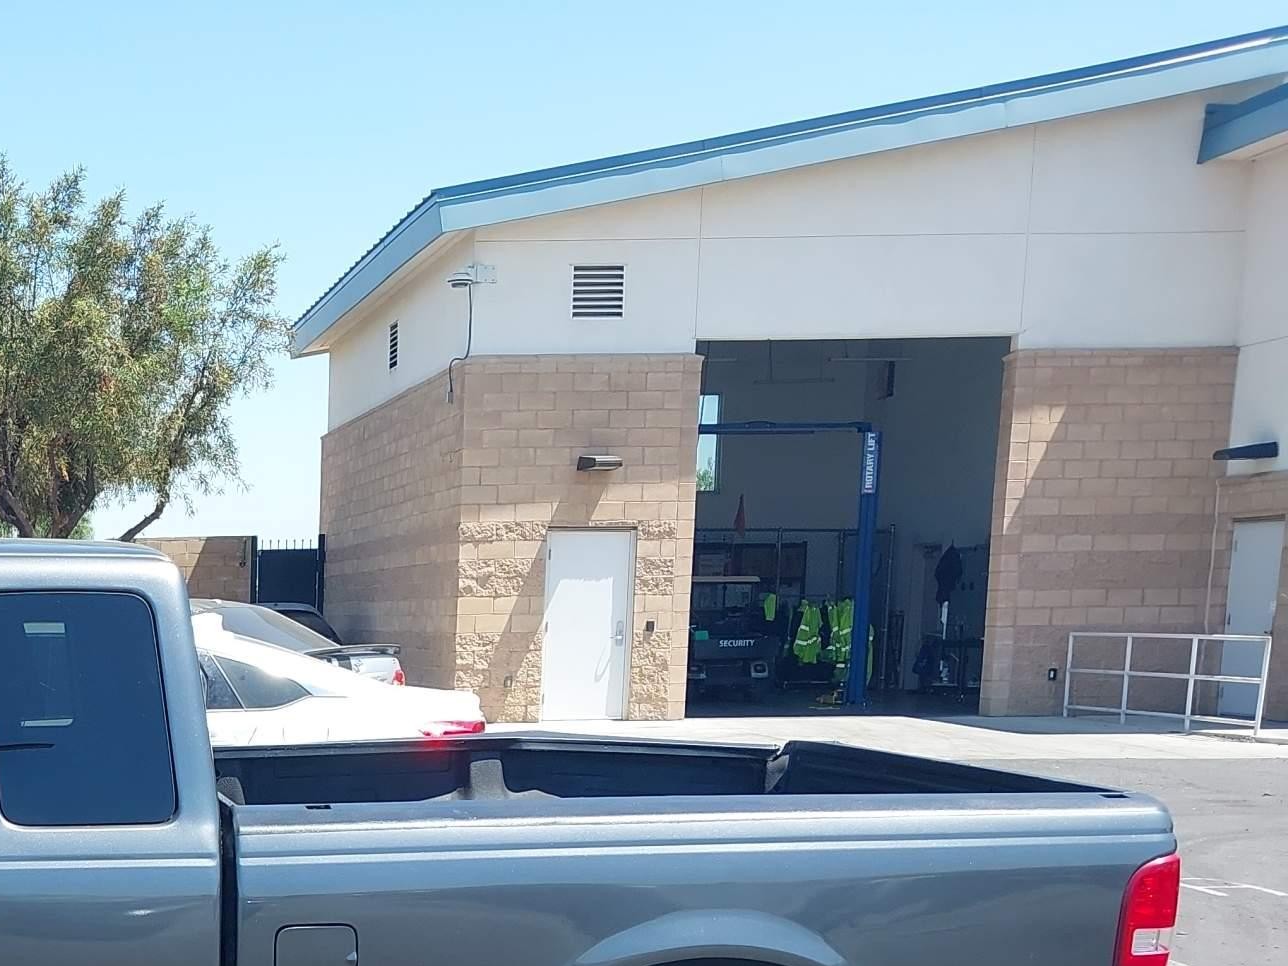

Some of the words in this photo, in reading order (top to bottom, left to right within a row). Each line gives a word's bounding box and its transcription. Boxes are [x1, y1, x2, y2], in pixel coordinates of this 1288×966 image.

[867, 432, 876, 451] LIFT
[865, 453, 875, 489] ROTARY
[719, 639, 755, 648] SECURITY
